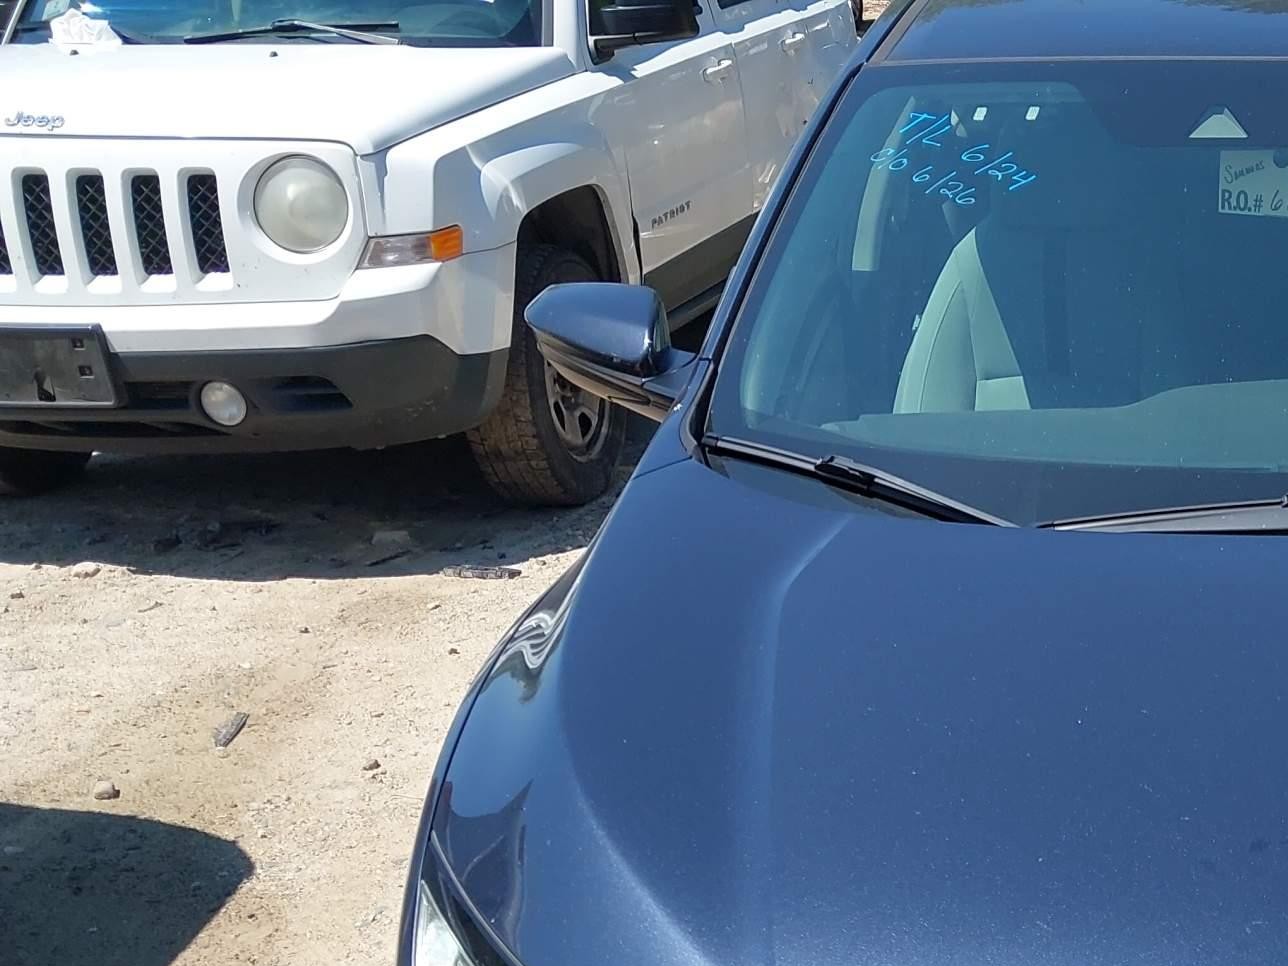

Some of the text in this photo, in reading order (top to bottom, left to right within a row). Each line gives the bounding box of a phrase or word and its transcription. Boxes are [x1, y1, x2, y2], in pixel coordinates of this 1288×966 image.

[4, 111, 66, 132] Jeep
[961, 143, 1037, 191] 6/24
[912, 166, 976, 205] 6/26
[651, 199, 692, 229] PATRIOT
